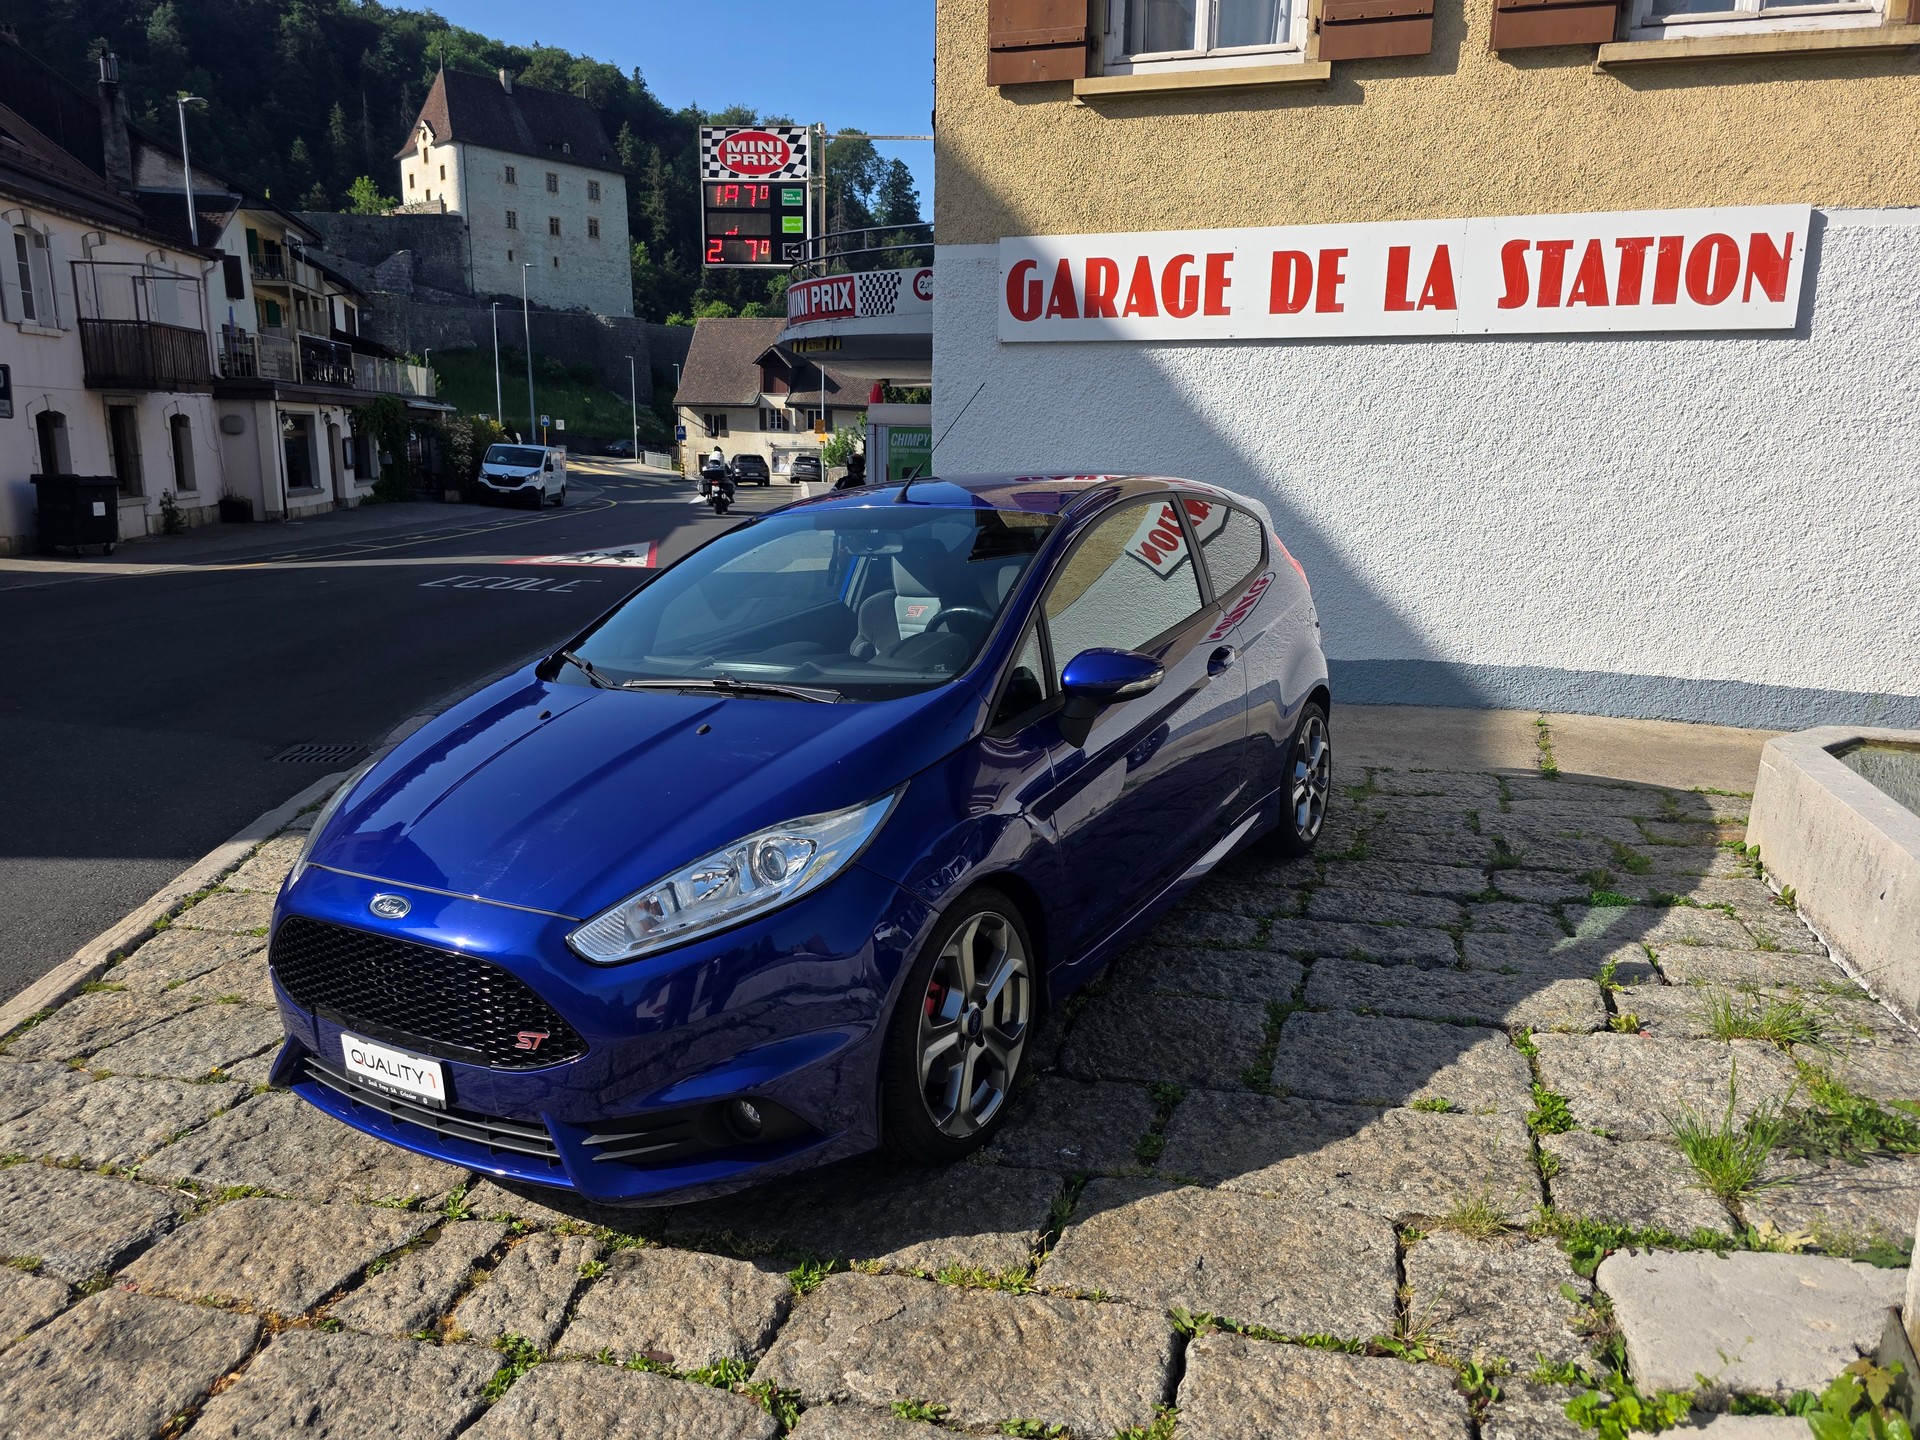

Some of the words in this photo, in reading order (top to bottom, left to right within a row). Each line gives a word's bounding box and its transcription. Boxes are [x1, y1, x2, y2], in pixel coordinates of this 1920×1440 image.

[726, 140, 783, 153] MINI
[726, 154, 783, 166] PRIX
[1005, 252, 1235, 322] GARAGE
[1269, 248, 1349, 315] DE
[1383, 244, 1458, 312] LA
[1497, 231, 1795, 310] STATION
[789, 288, 808, 322] MINI
[810, 281, 853, 314] PRIX
[890, 433, 931, 447] CHIMPY
[418, 575, 602, 593] ECOLE
[905, 605, 929, 618] ST
[515, 1031, 550, 1050] ST
[351, 1049, 424, 1085] QUALITY
